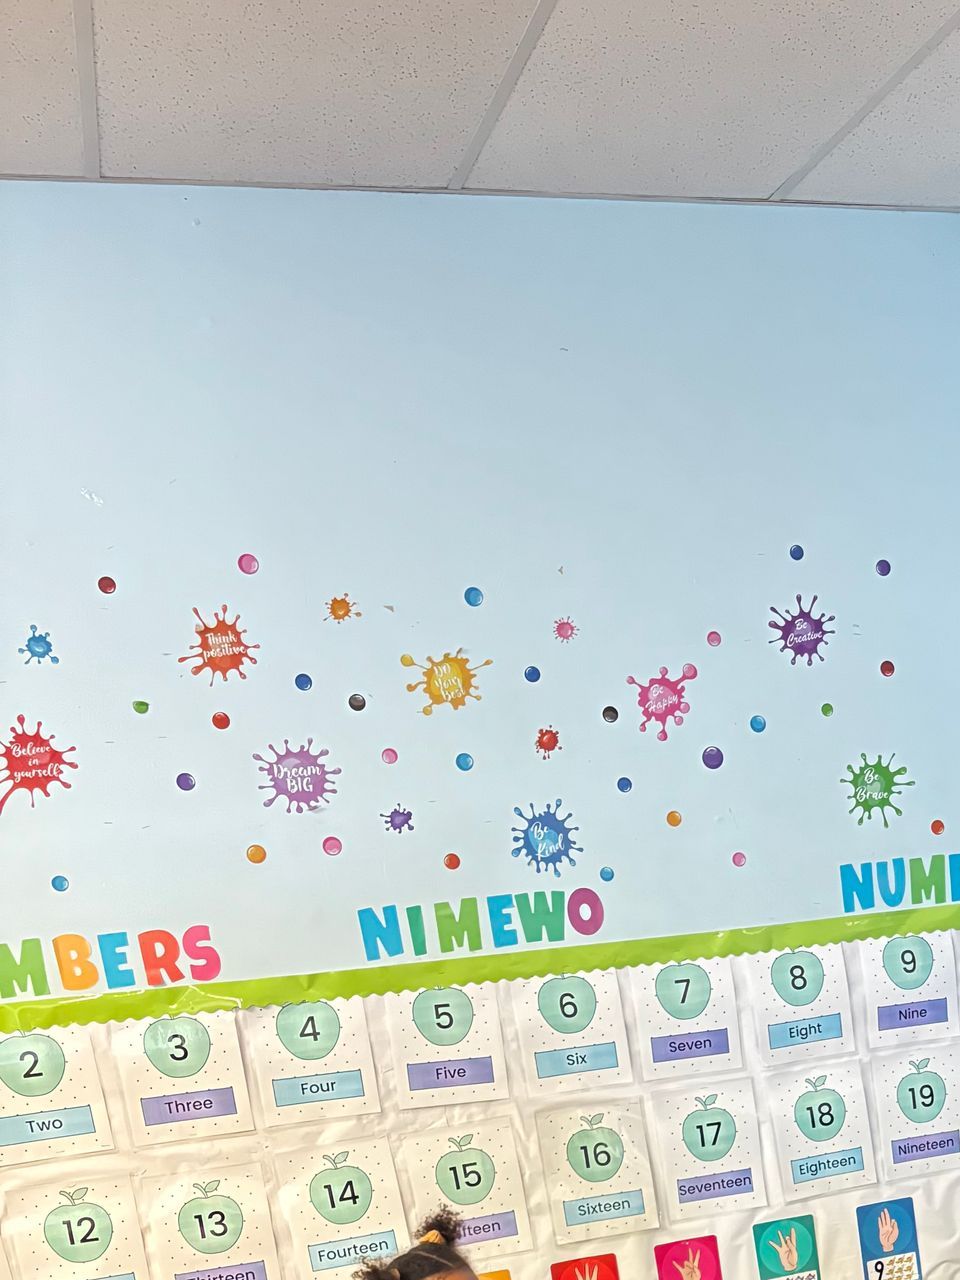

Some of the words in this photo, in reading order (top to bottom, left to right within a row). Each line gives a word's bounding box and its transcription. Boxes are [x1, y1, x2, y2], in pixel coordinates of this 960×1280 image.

[794, 618, 808, 631] Be
[205, 630, 237, 646] Think
[786, 629, 823, 647] Creative
[203, 644, 246, 662] positive
[651, 686, 665, 699] Be
[645, 693, 679, 714] Happy
[11, 742, 51, 756] Believe
[28, 757, 39, 766] in
[14, 763, 60, 783] yourself
[273, 764, 322, 779] Dream
[863, 769, 880, 784] Be
[286, 777, 313, 793] BIG
[856, 786, 889, 802] Brave
[357, 887, 605, 962] NIMEWO
[790, 965, 807, 990] 8
[559, 993, 578, 1019] 6
[898, 1007, 928, 1022] Nine
[788, 1023, 823, 1041] Eight
[167, 1034, 189, 1061] 3
[668, 1037, 712, 1053] Seven
[566, 1053, 588, 1066] Six
[435, 1066, 467, 1080] Five
[300, 1079, 336, 1095] Four
[164, 1098, 213, 1115] Three
[25, 1118, 63, 1133] Two
[898, 1137, 954, 1155] Nineteen
[580, 1142, 612, 1169] 16
[799, 1155, 856, 1177] Eighteen
[679, 1175, 752, 1197] Seventeen
[578, 1198, 631, 1217] Sixteen
[194, 1211, 228, 1239] 13
[318, 1238, 389, 1263] Fourteen
